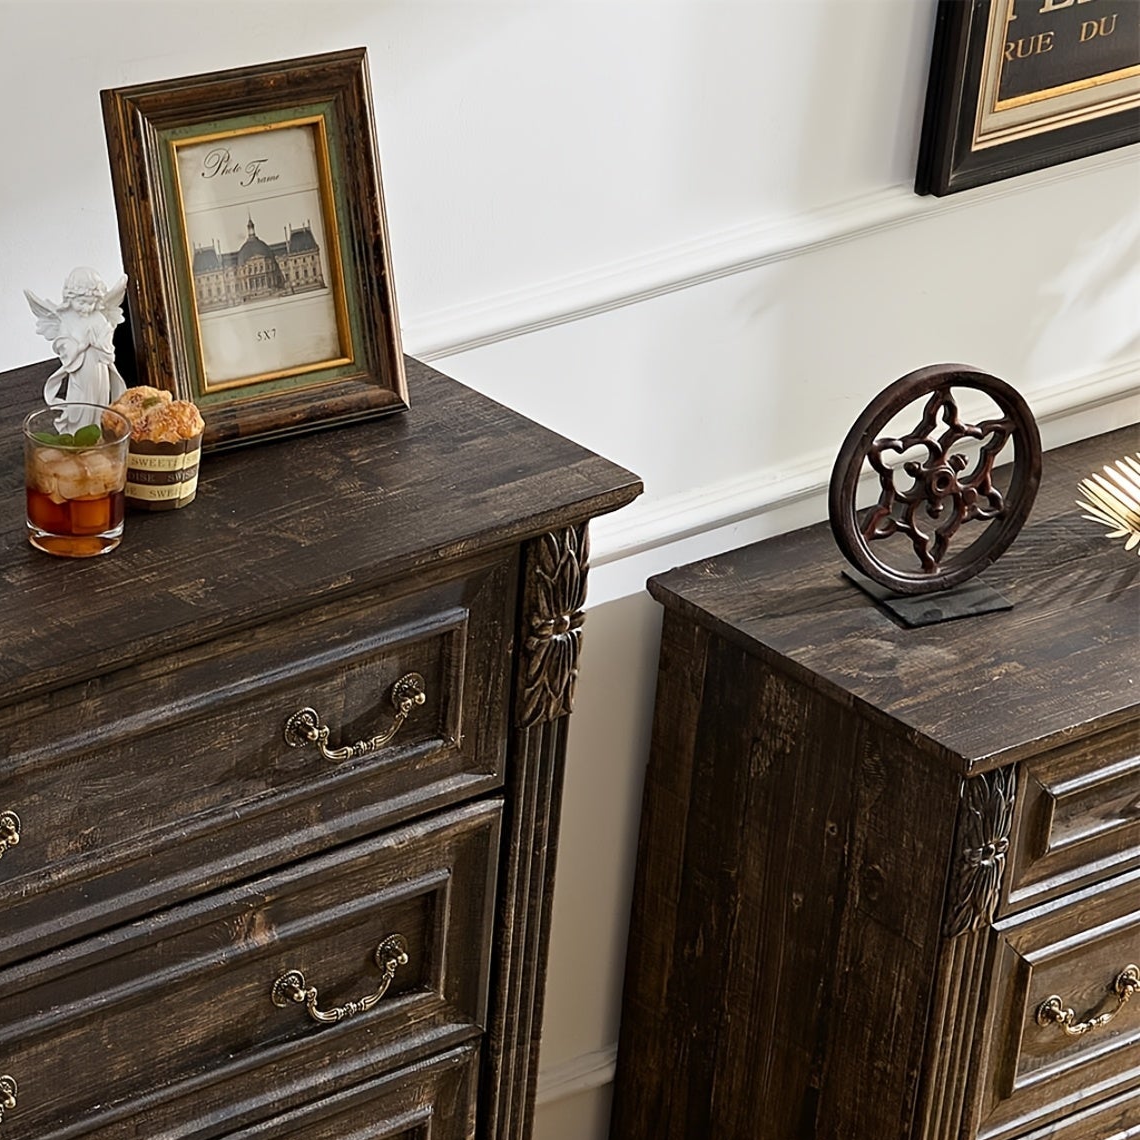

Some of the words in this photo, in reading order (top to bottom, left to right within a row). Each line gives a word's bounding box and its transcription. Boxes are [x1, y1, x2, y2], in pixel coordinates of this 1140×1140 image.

[1079, 14, 1118, 43] DU
[201, 147, 242, 178] Photo
[240, 158, 281, 187] Frame
[256, 328, 278, 341] 5X7
